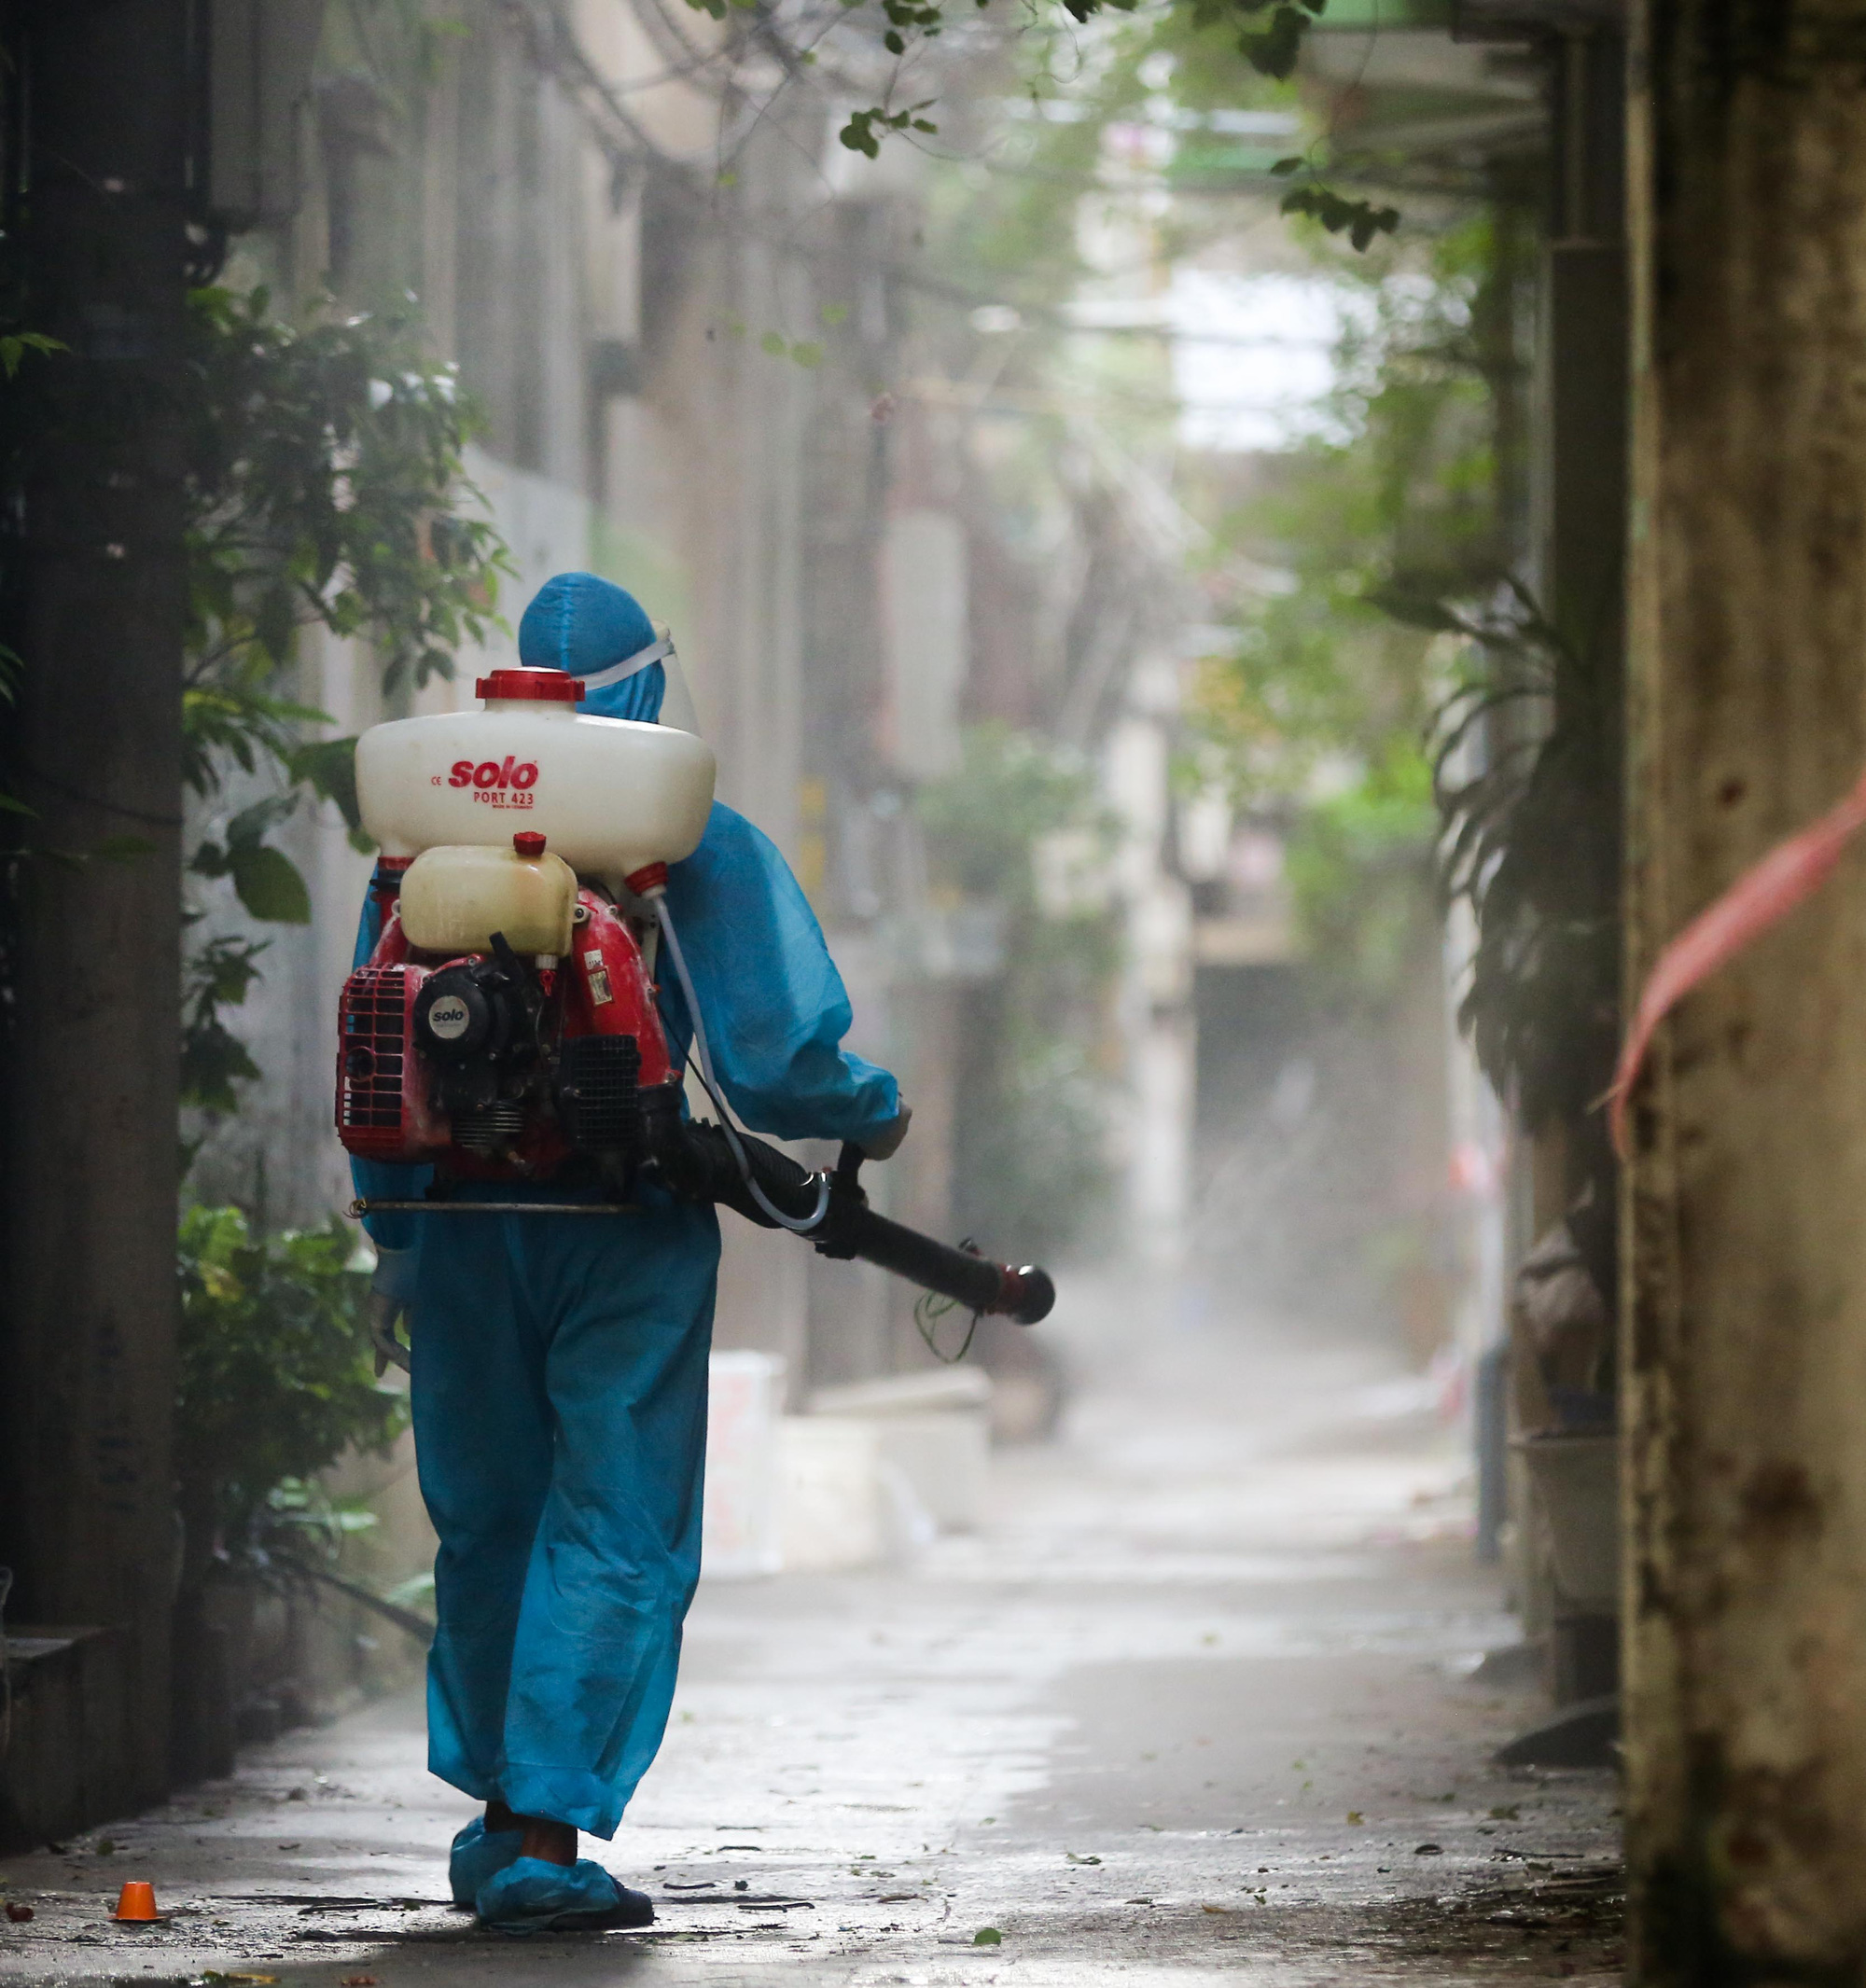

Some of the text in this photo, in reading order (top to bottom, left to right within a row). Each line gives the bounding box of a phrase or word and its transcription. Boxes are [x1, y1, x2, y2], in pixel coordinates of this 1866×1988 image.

[448, 756, 538, 790] solo
[474, 791, 534, 804] PORT 423
[433, 1008, 464, 1022] solo
